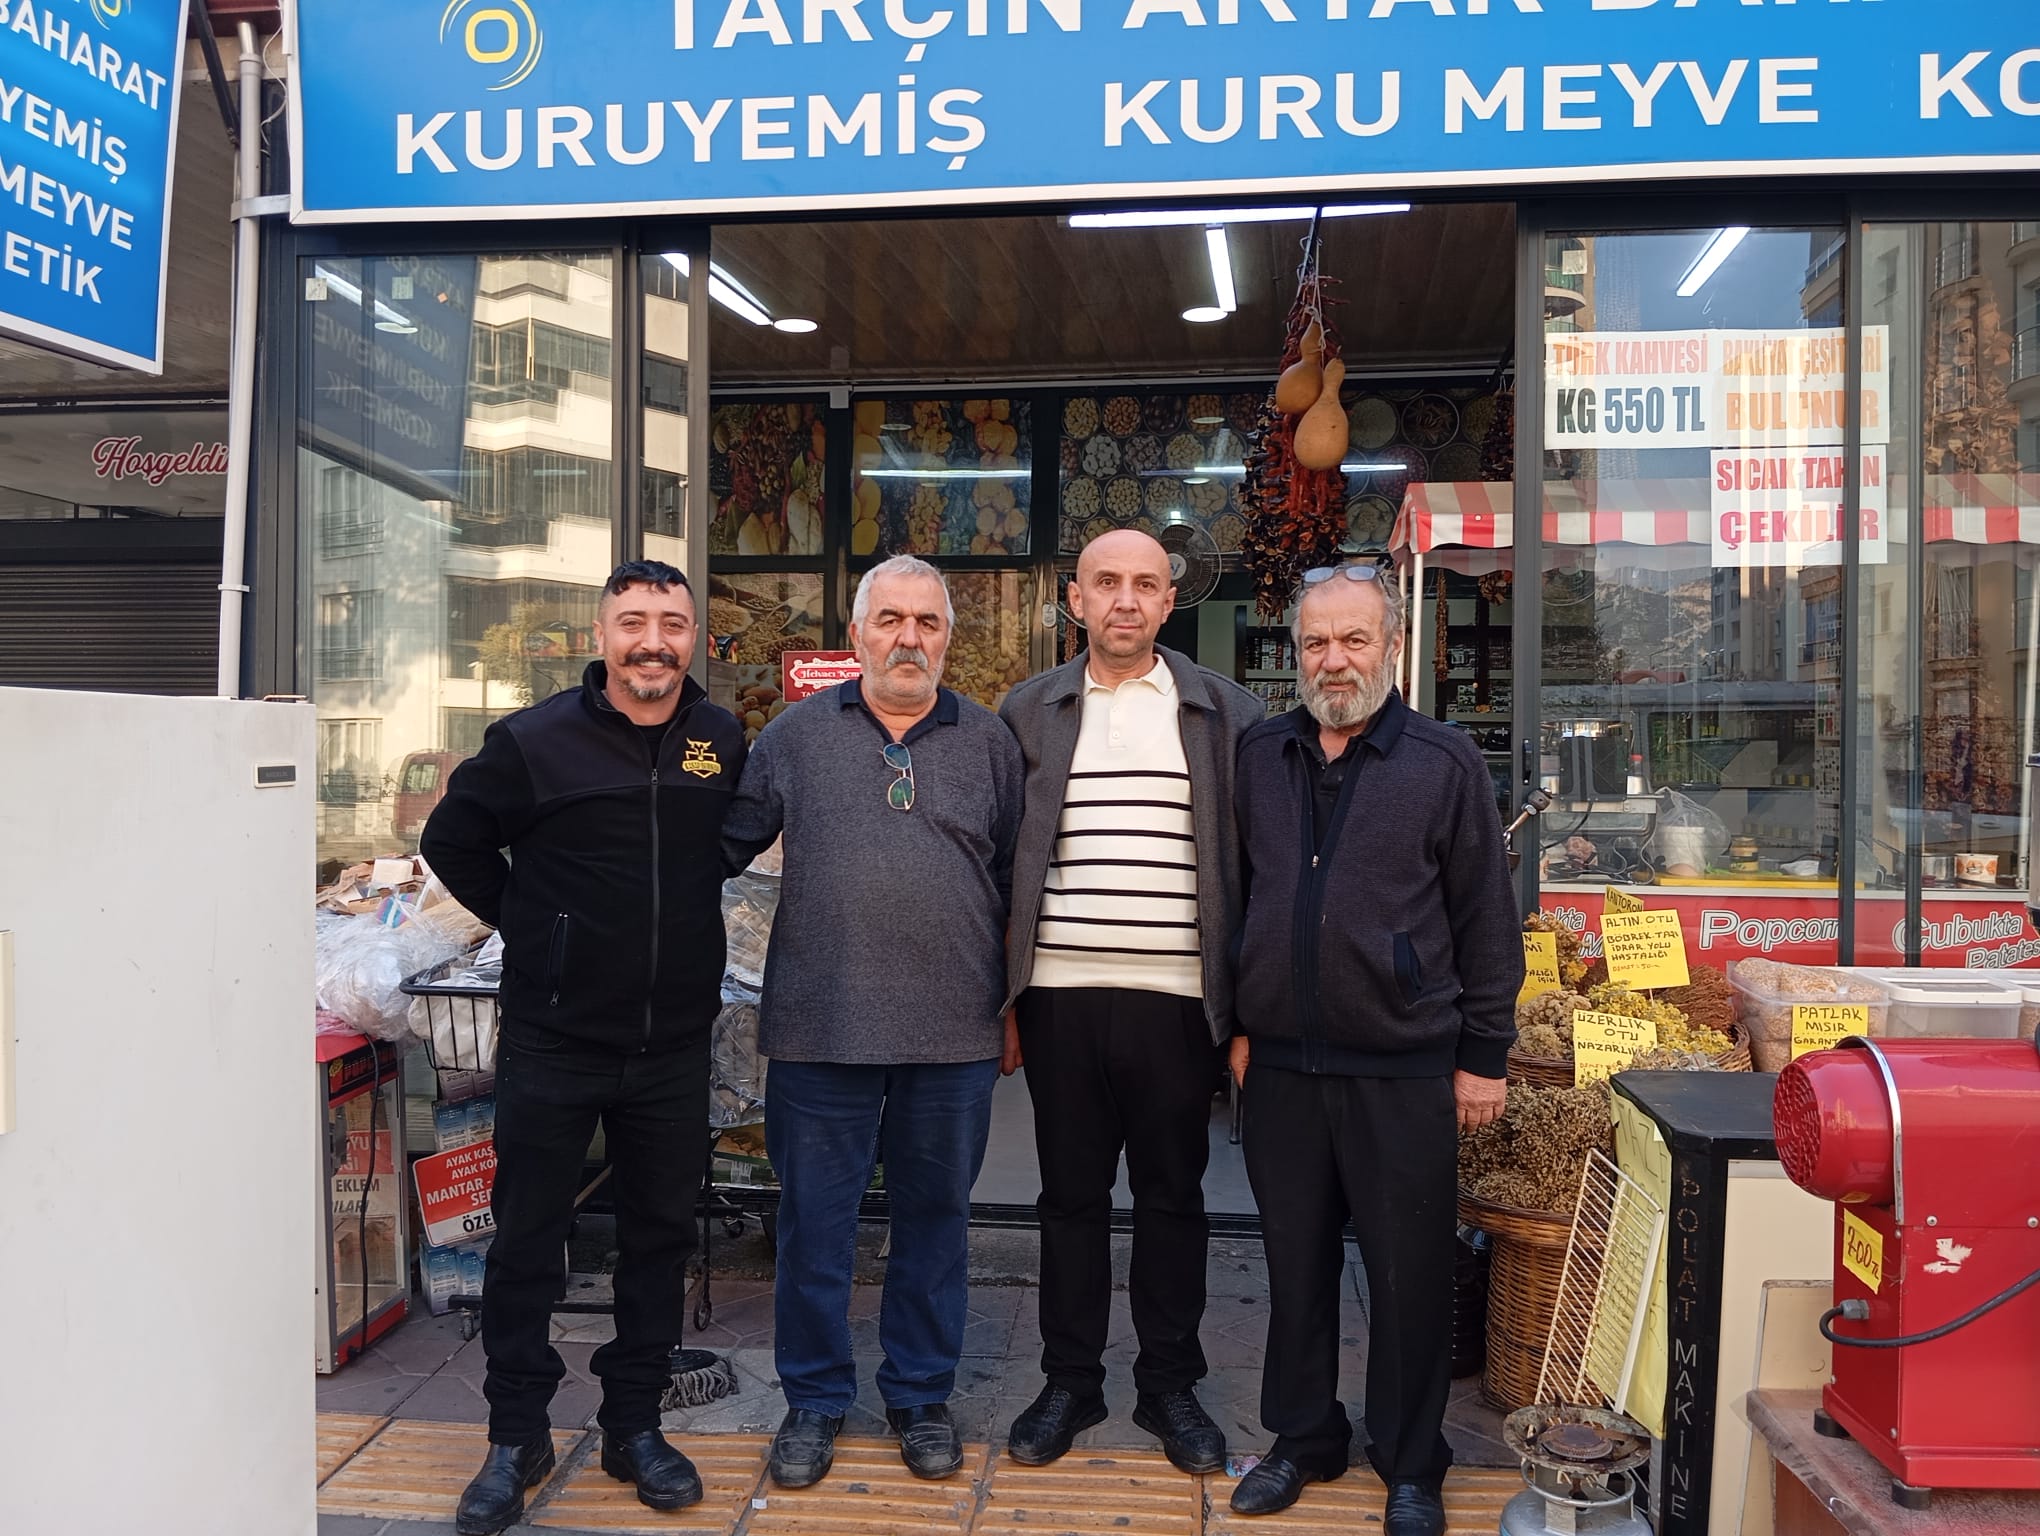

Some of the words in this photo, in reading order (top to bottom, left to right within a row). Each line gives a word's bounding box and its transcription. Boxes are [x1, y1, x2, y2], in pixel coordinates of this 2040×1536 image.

[396, 75, 986, 174] KURUYEMİŞ
[1104, 71, 1400, 147] KURU
[1444, 57, 1819, 134] MEYVE
[5, 231, 103, 304] ETİK
[1553, 336, 1610, 375] TÜRK
[1616, 333, 1709, 375] KAHVESİ
[1800, 329, 1881, 382] ÇEŞİTRİ
[1556, 387, 1597, 434] KG
[1604, 386, 1665, 433] 550
[1672, 386, 1705, 432] TL
[1716, 457, 1796, 491] SICAK
[1802, 455, 1880, 489] TAHN
[1645, 915, 1674, 924] OTU
[1611, 950, 1668, 961] HASTALIĞI
[1647, 942, 1671, 950] YOLU
[1799, 1006, 1863, 1021] PATLAK
[1604, 1028, 1639, 1041] OTU
[1805, 1021, 1849, 1033] MISIR
[1793, 1036, 1842, 1046] GARANT
[445, 1152, 472, 1169] AYAK
[473, 1145, 496, 1160] KAŞ
[451, 1164, 479, 1180] AYAK
[425, 1177, 485, 1206] MANTAR
